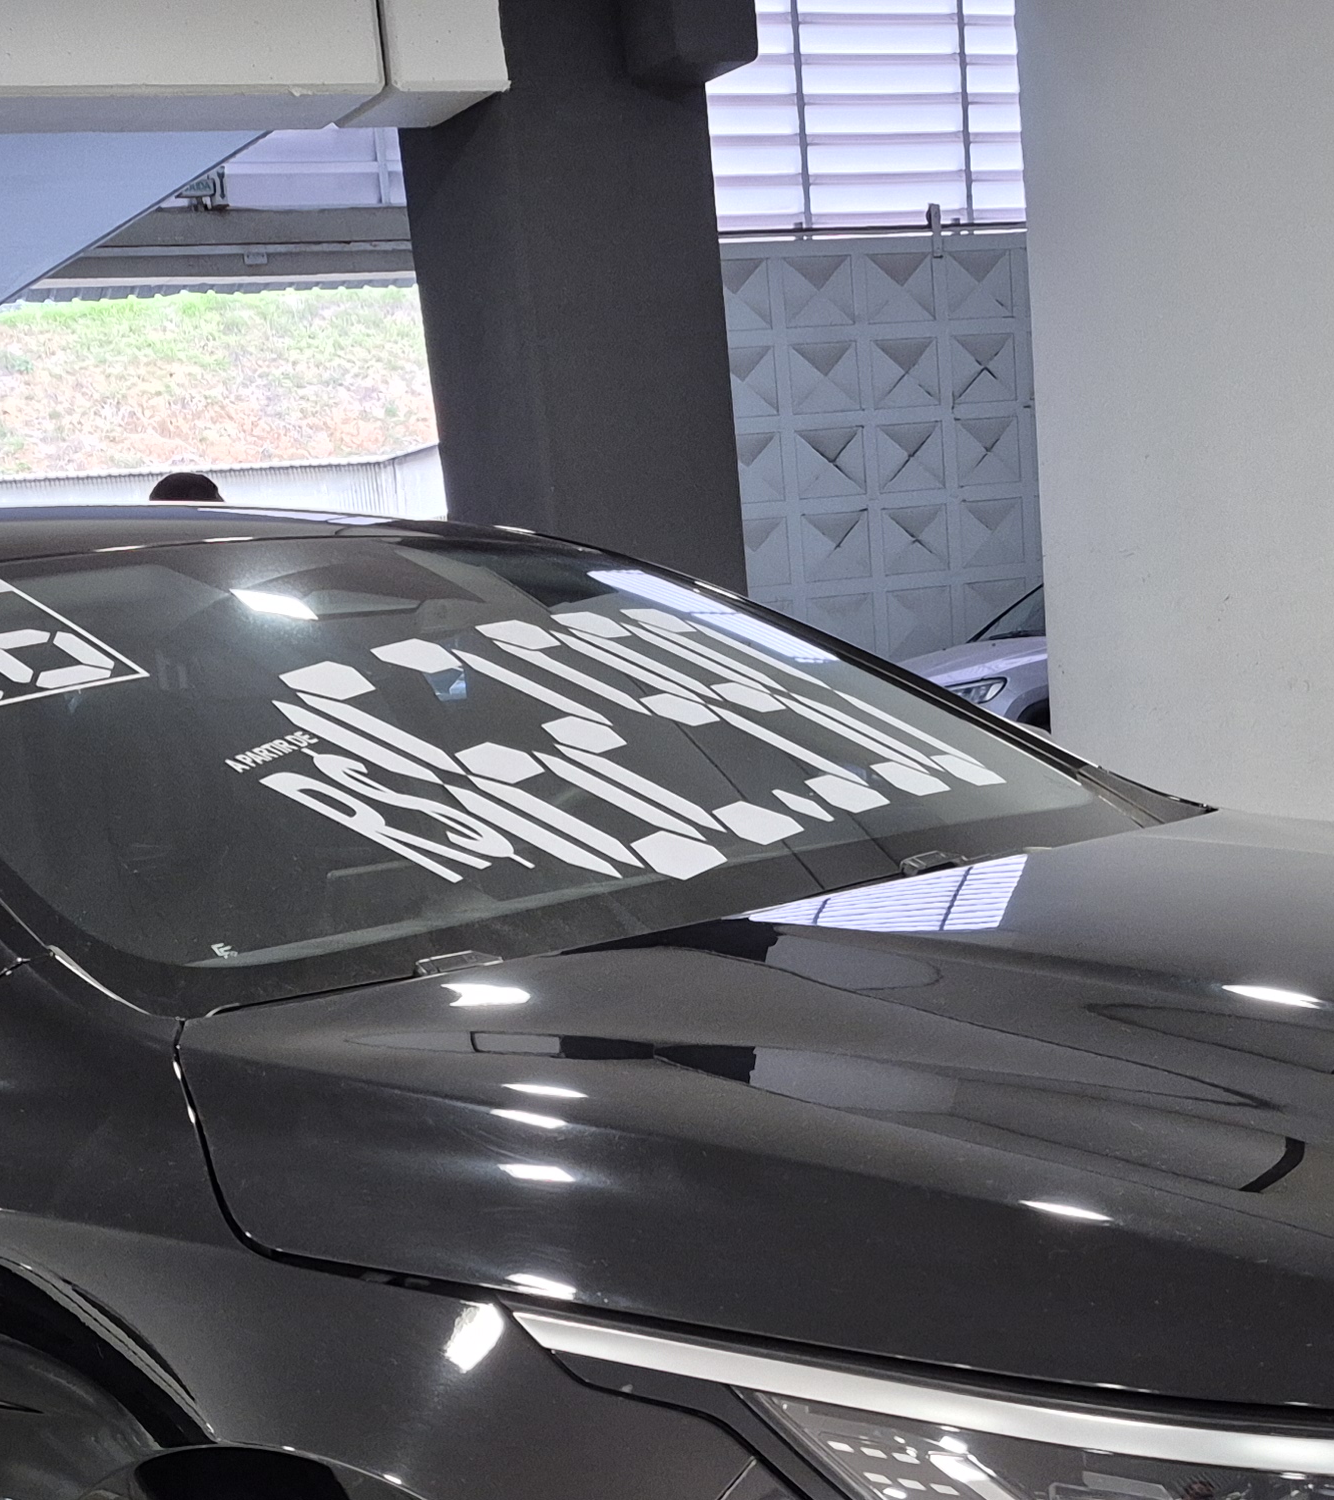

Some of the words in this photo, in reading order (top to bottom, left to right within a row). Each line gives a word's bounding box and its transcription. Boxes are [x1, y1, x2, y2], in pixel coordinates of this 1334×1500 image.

[284, 731, 319, 747] DE
[234, 739, 299, 767] PARTIR
[225, 759, 250, 773] A
